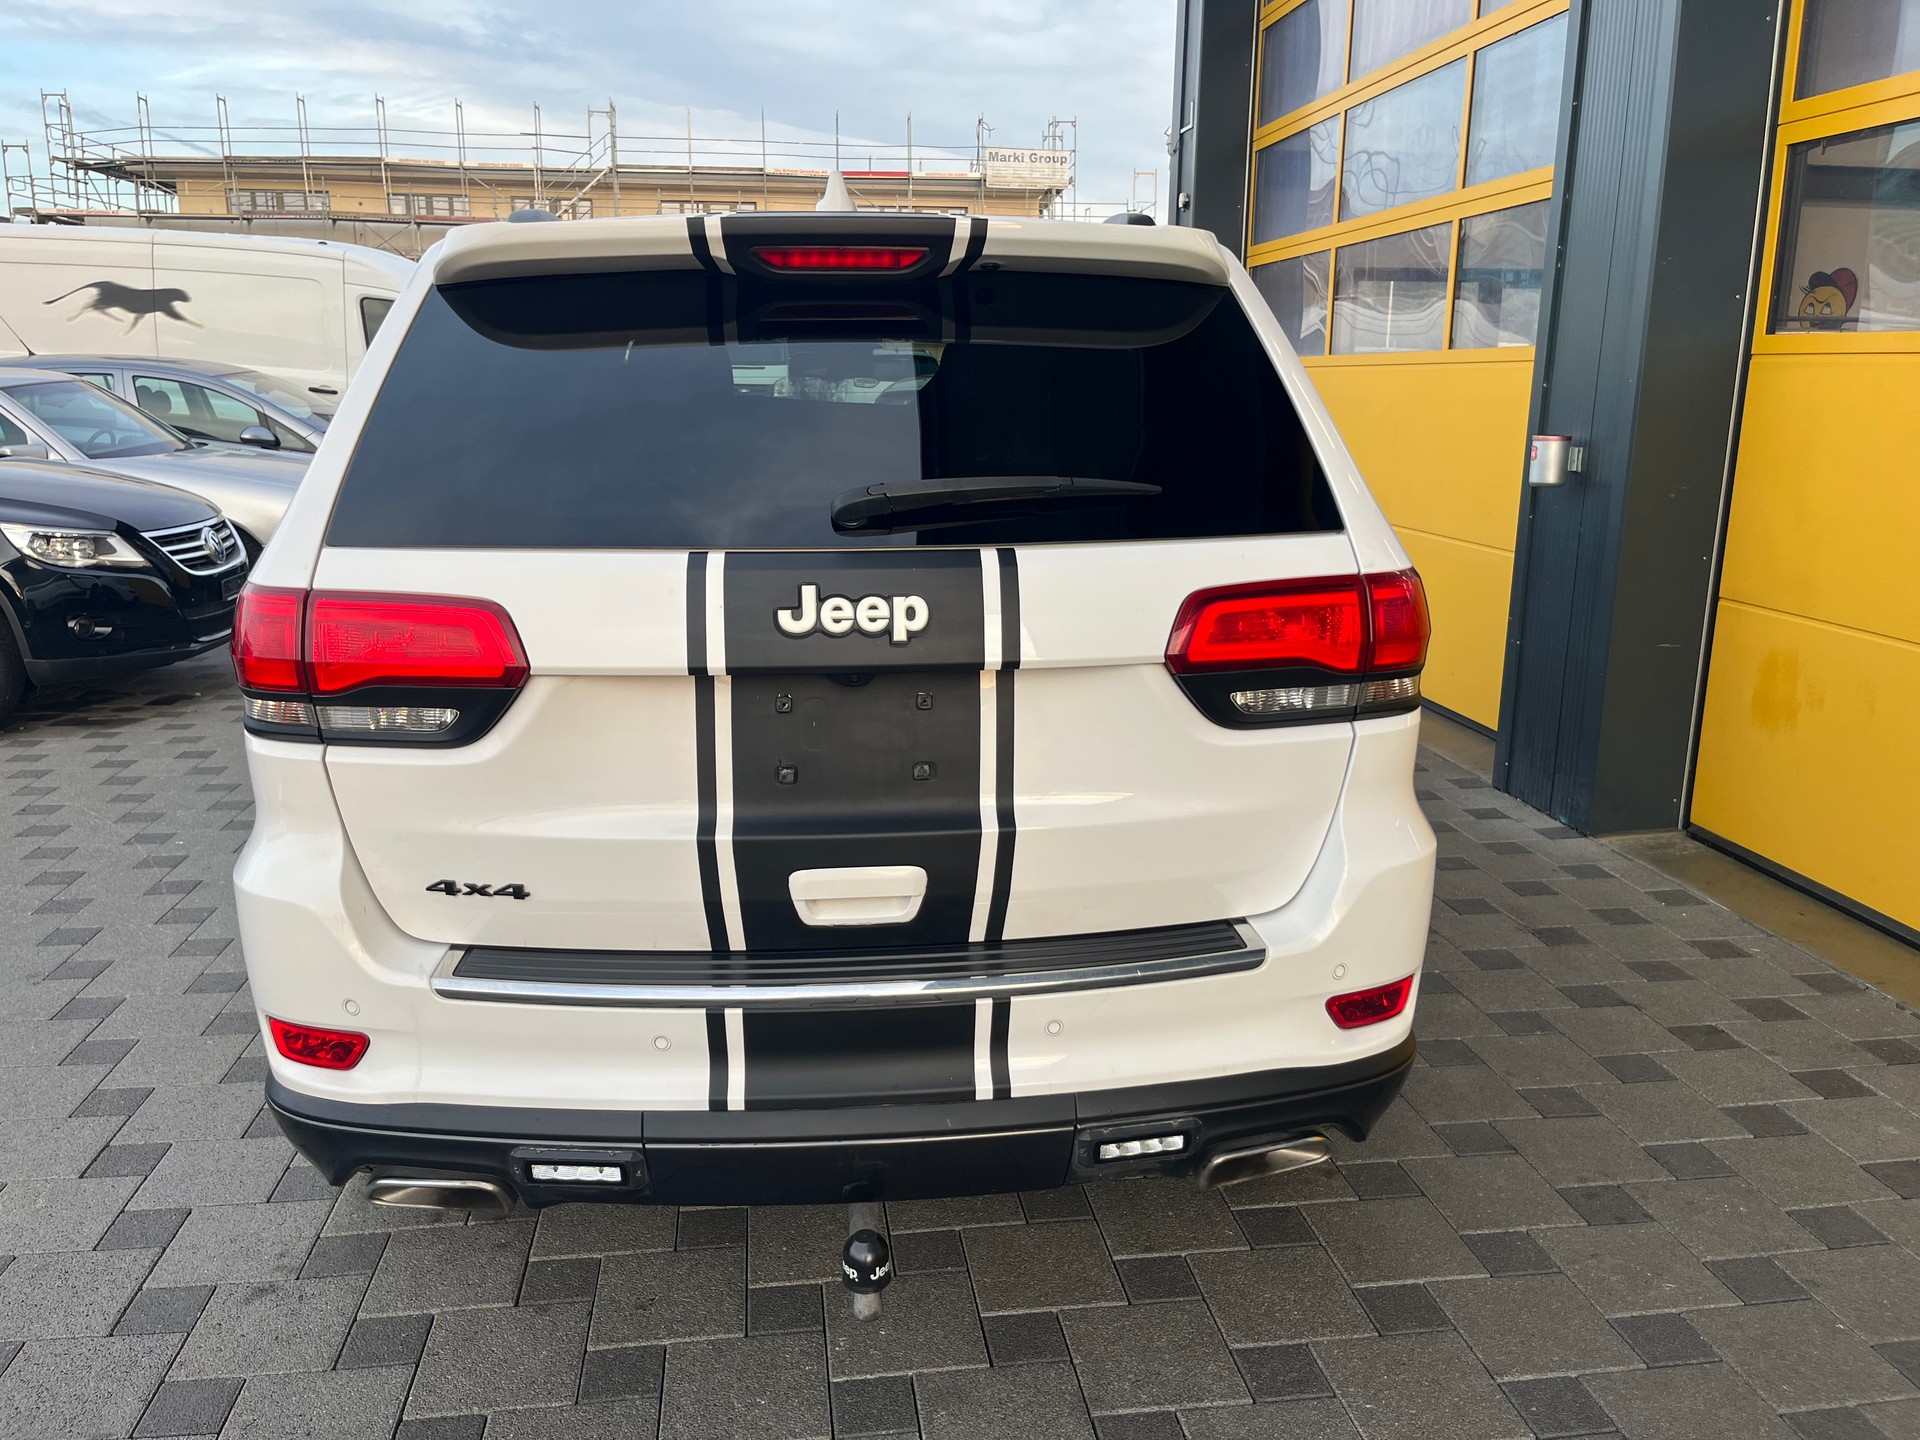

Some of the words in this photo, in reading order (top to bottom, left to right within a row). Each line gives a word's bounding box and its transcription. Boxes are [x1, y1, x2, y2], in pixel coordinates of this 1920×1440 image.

[988, 151, 1025, 163] Marki
[1029, 152, 1068, 166] Group
[776, 583, 930, 643] Jeep
[425, 879, 531, 900] 4x4
